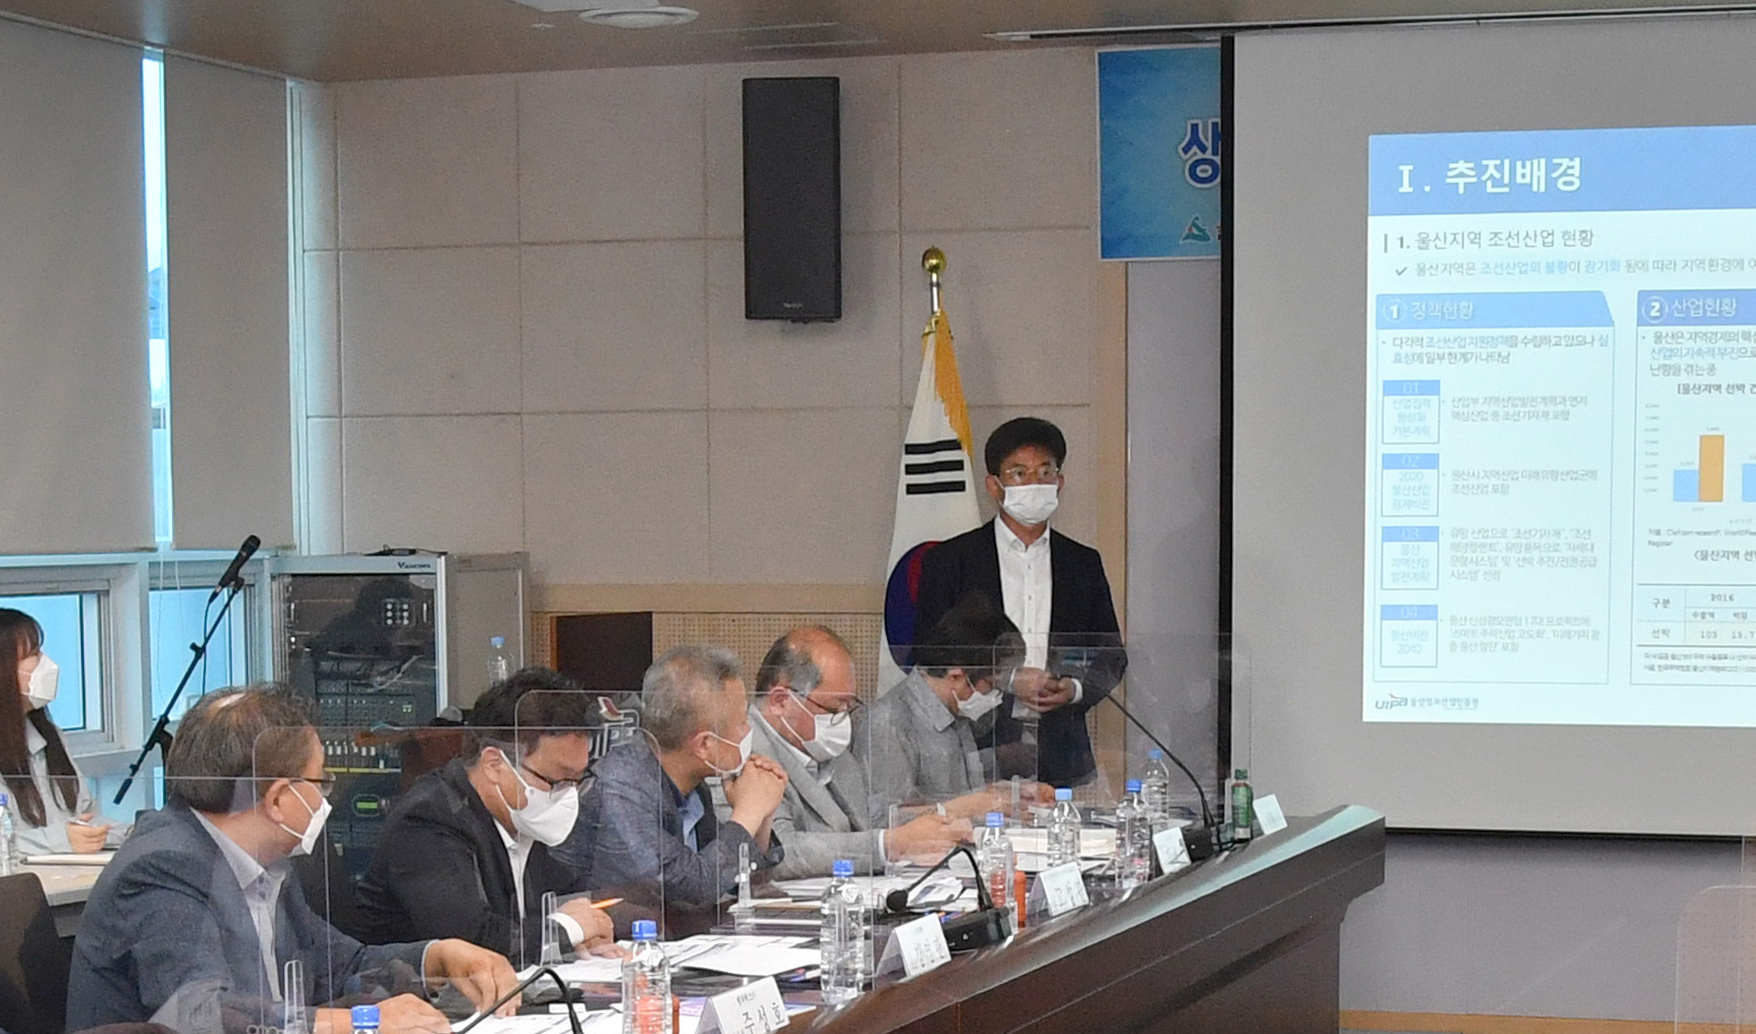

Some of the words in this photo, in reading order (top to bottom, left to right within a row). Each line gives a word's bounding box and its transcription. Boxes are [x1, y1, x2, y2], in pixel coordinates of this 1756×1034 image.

[1445, 156, 1583, 195] 추진배경
[1397, 235, 1410, 250] 1.
[1415, 231, 1483, 251] 울산지역
[1487, 230, 1556, 250] 조선산업
[1560, 229, 1595, 249] 현황
[1416, 260, 1477, 276] 울산지역은
[1480, 260, 1542, 275] 조선산업의
[1545, 259, 1581, 275] 불황이
[1585, 259, 1621, 274] 장기화
[1624, 258, 1649, 274] 됨에
[1652, 258, 1678, 274] 따라
[1681, 258, 1745, 273] 지역환경에
[1411, 302, 1474, 320] 정책현황
[1671, 298, 1737, 317] 산업현황
